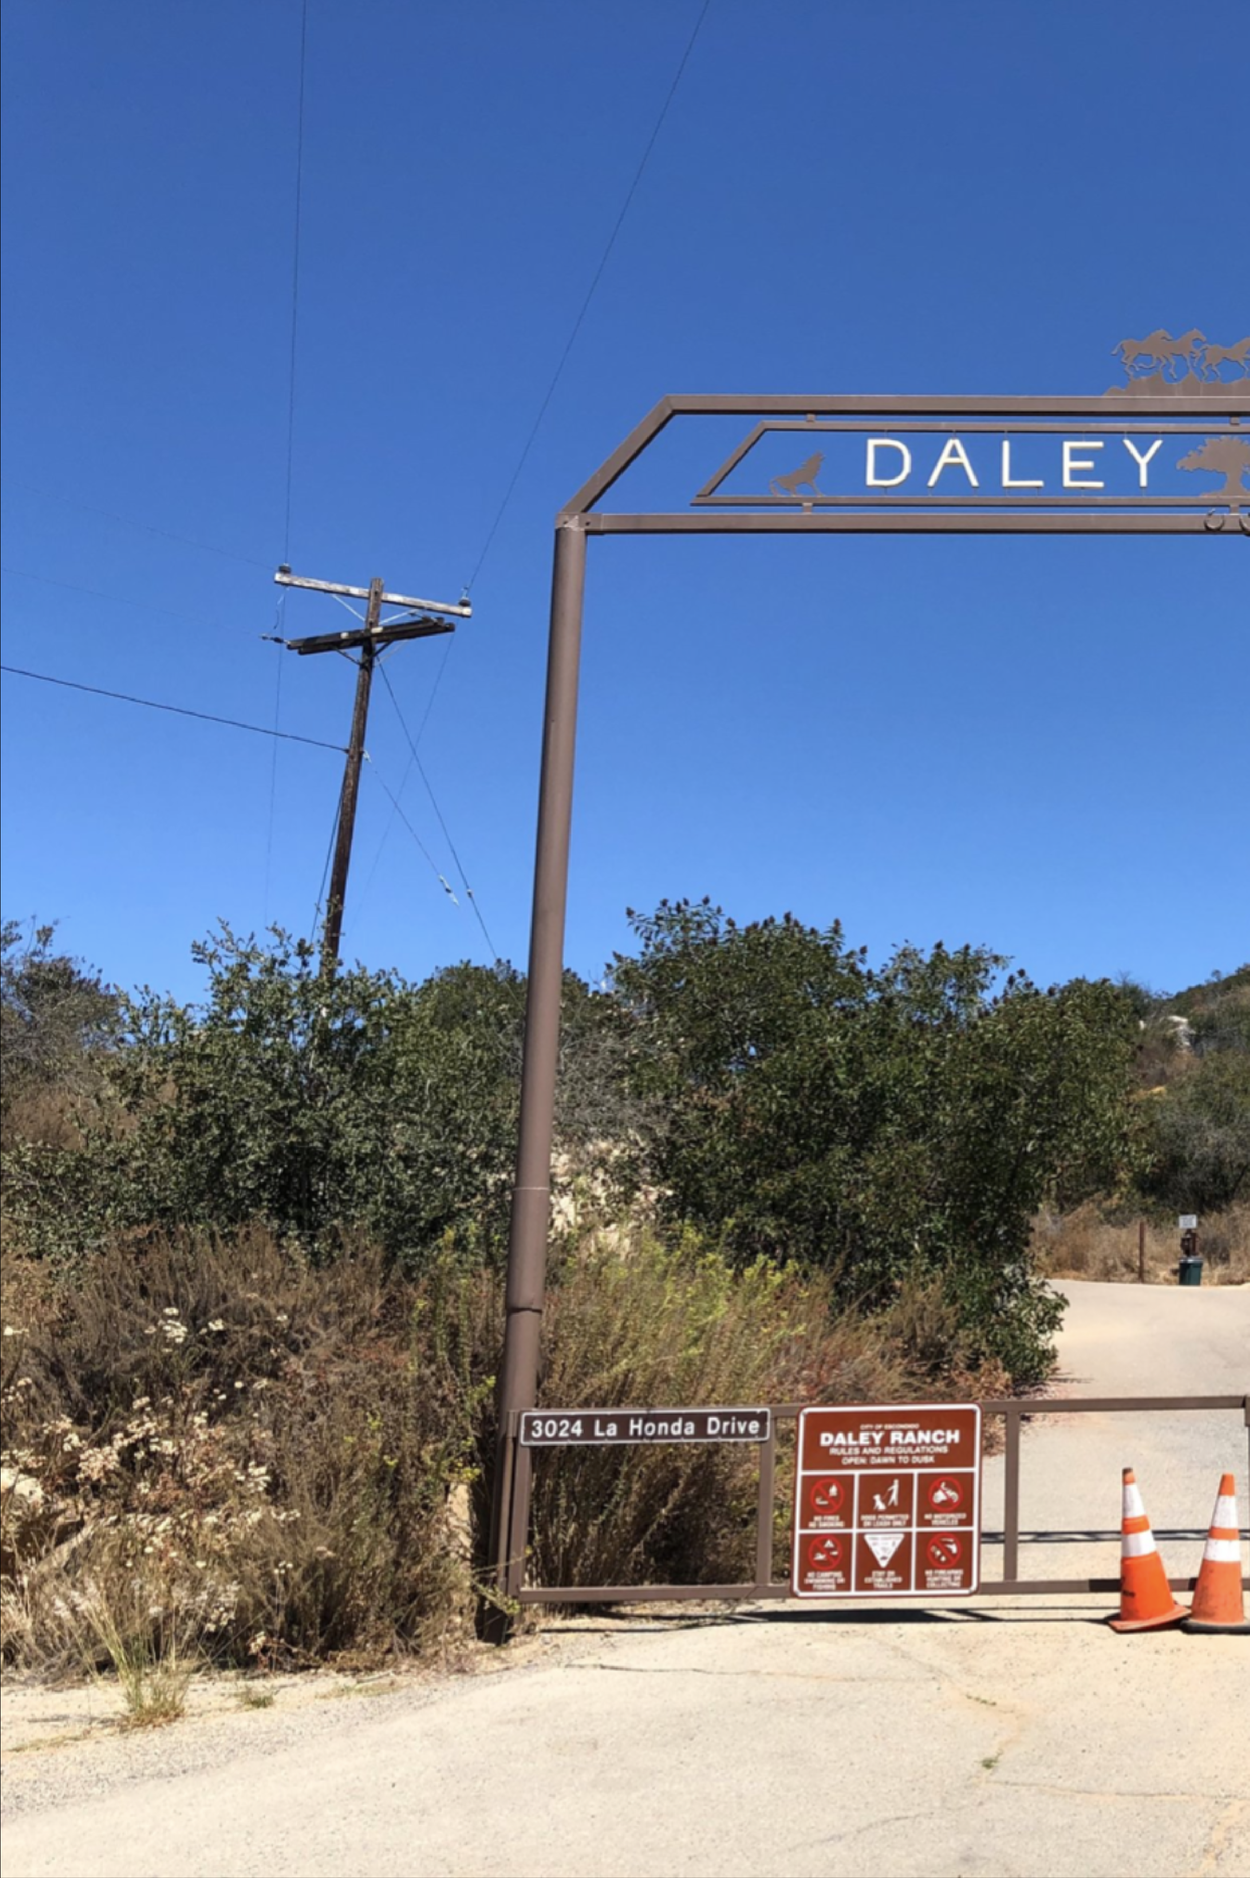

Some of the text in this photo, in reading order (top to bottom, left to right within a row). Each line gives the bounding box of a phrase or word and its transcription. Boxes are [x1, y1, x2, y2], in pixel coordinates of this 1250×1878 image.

[864, 437, 1163, 489] DALEY
[531, 1416, 760, 1439] 3024 La Honda Drive
[820, 1429, 960, 1447] DALEY RANCH
[829, 1445, 948, 1456] RULES AND REGULATIONS
[870, 1455, 895, 1465] DAWN
[897, 1455, 909, 1464] TO
[911, 1455, 935, 1464] DUSK
